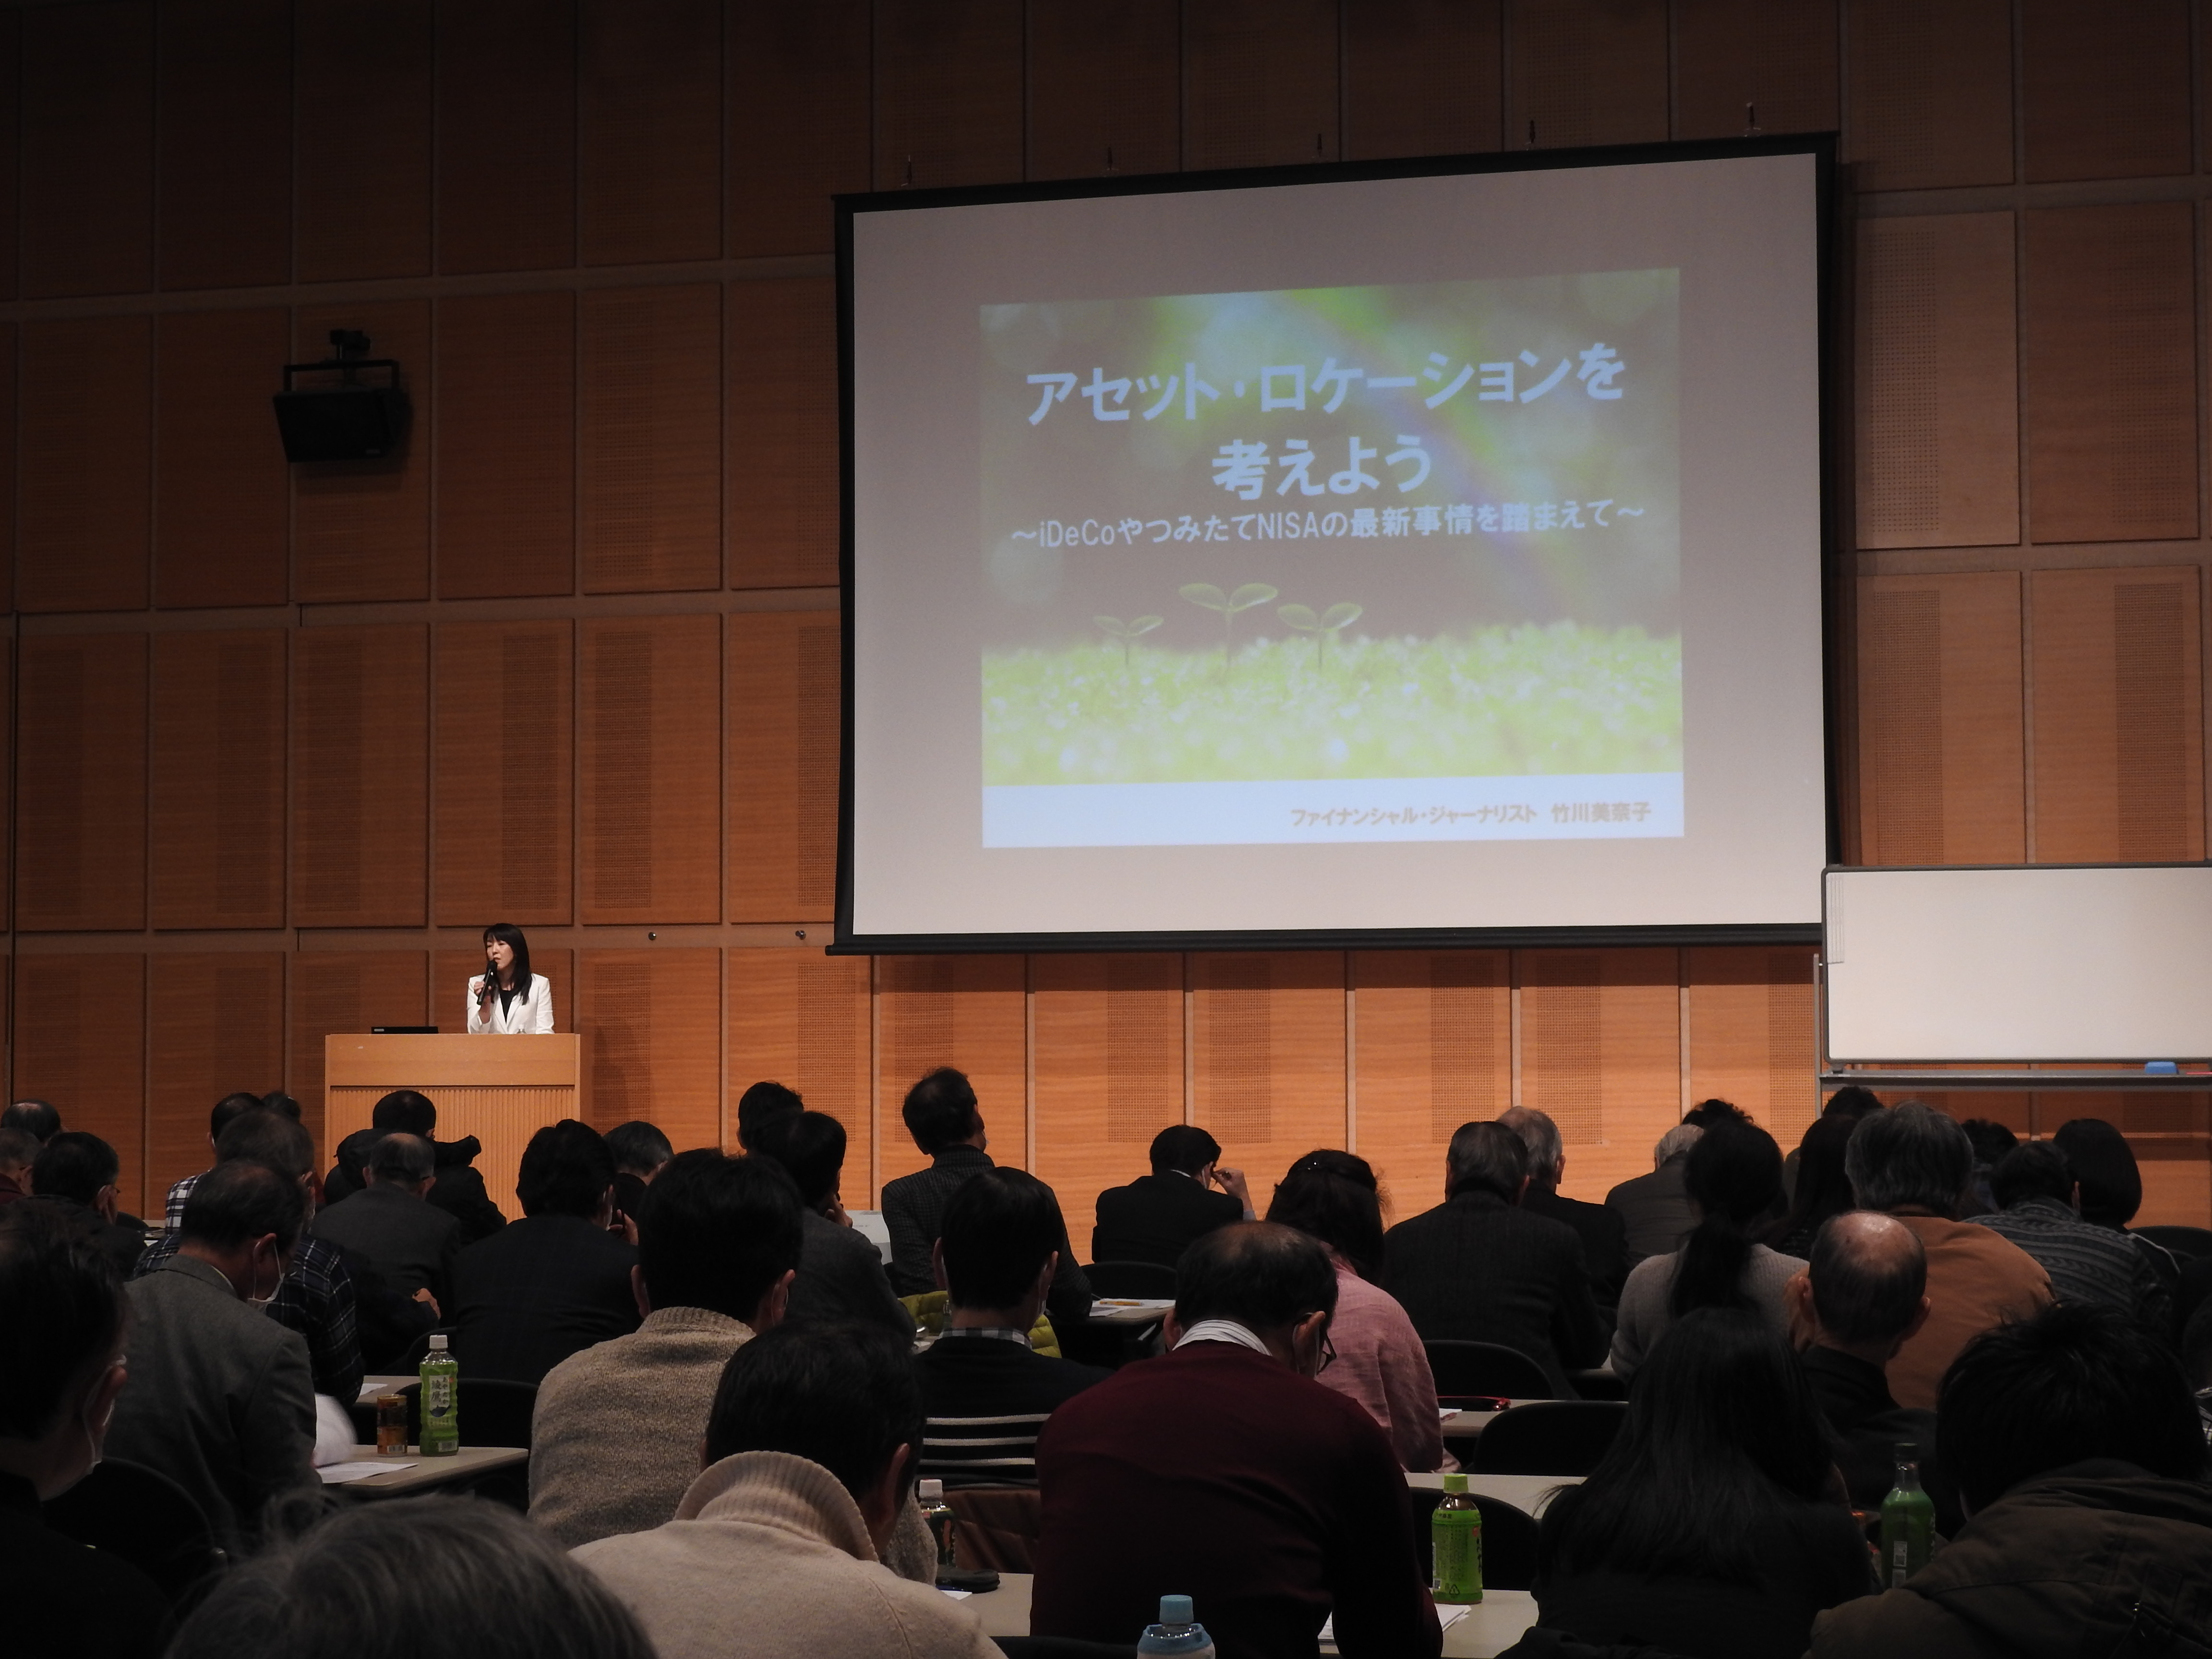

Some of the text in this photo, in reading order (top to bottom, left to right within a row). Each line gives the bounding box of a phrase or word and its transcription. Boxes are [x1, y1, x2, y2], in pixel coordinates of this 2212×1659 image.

[1026, 343, 1625, 425] アセット・ロケーションを
[1212, 435, 1431, 500] 考えよう
[1291, 804, 1537, 826] ファイナンシャル・ジャーナリスト
